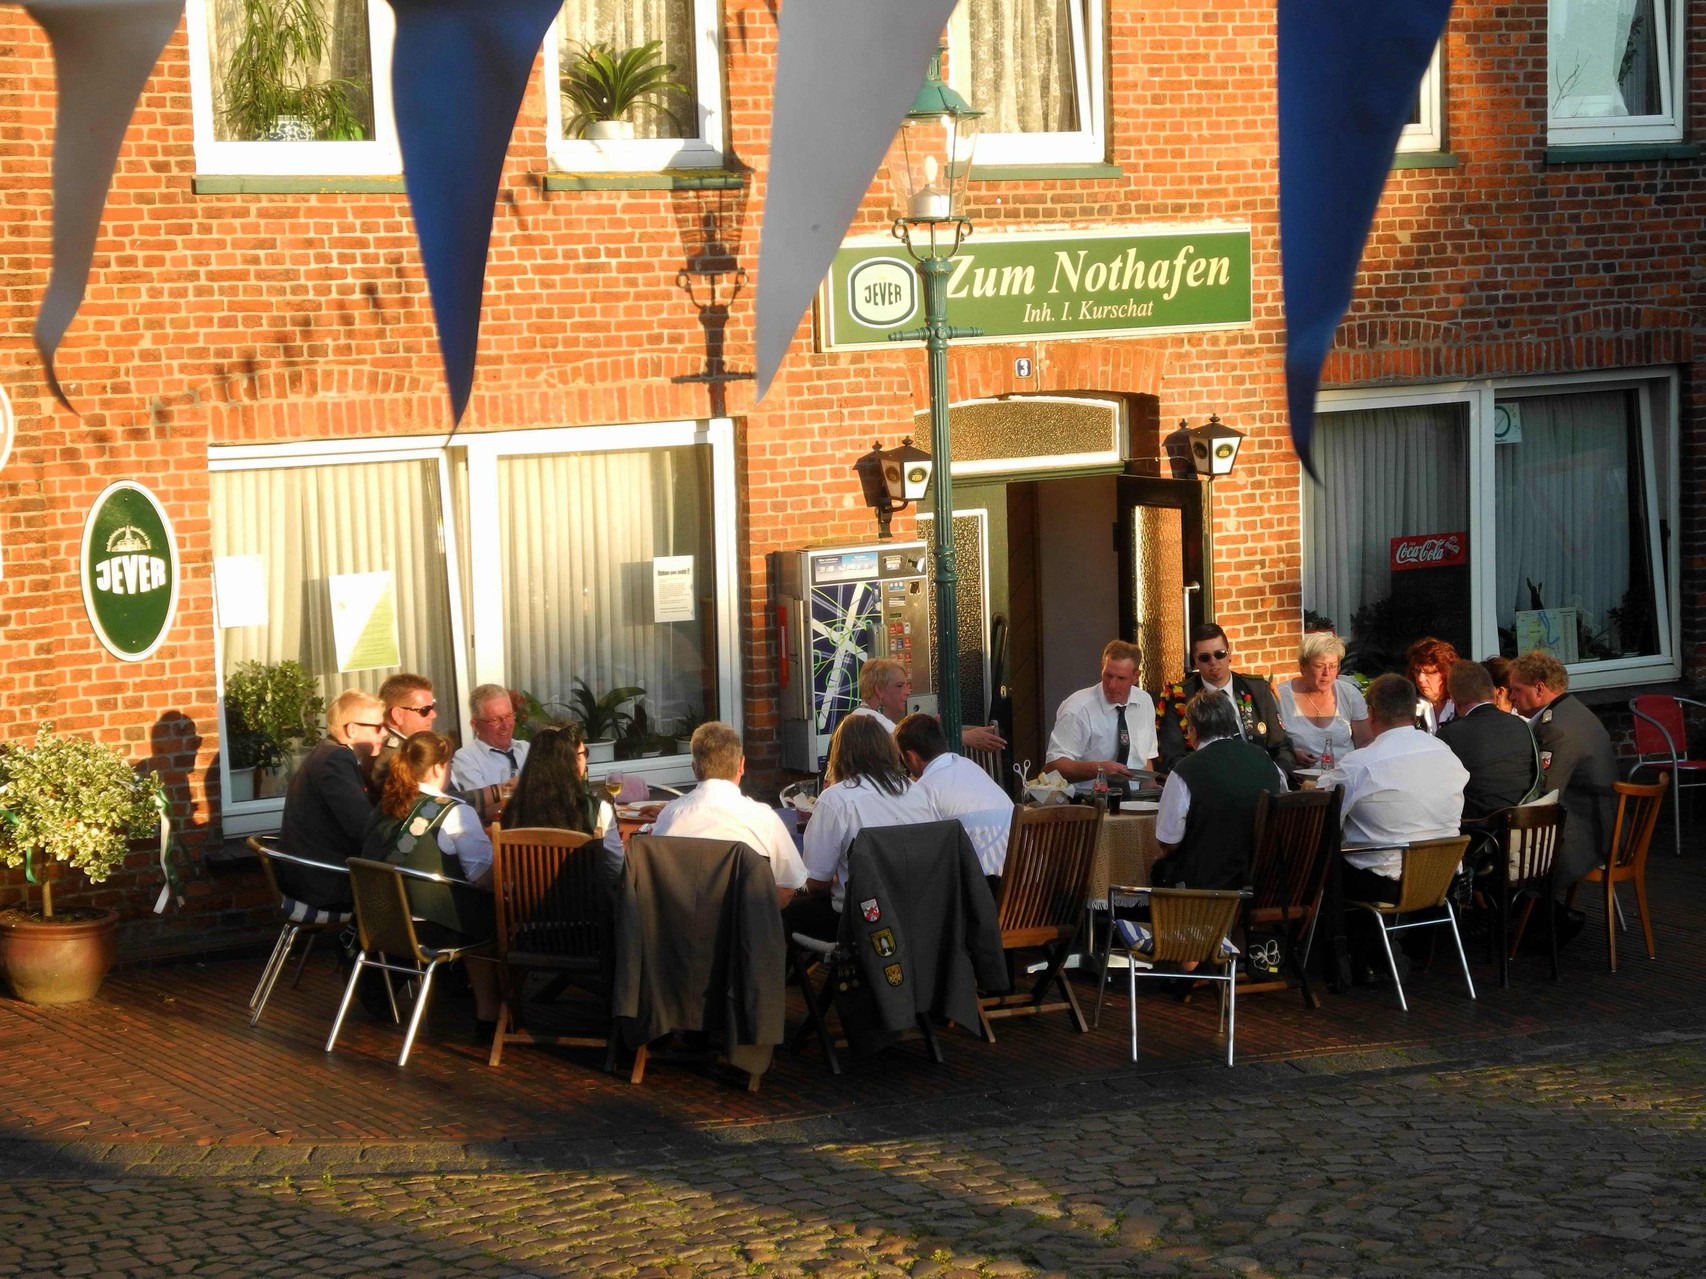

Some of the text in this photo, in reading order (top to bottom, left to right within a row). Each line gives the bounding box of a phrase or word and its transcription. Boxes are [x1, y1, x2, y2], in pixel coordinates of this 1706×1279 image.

[946, 245, 1230, 300] Zum Nothafen
[864, 282, 902, 306] JEVER
[1023, 303, 1056, 323] Inh.
[1079, 298, 1153, 320] Kurschat
[1019, 359, 1029, 376] 3
[1396, 539, 1445, 564] Coca-Cola
[95, 554, 166, 594] JEVER
